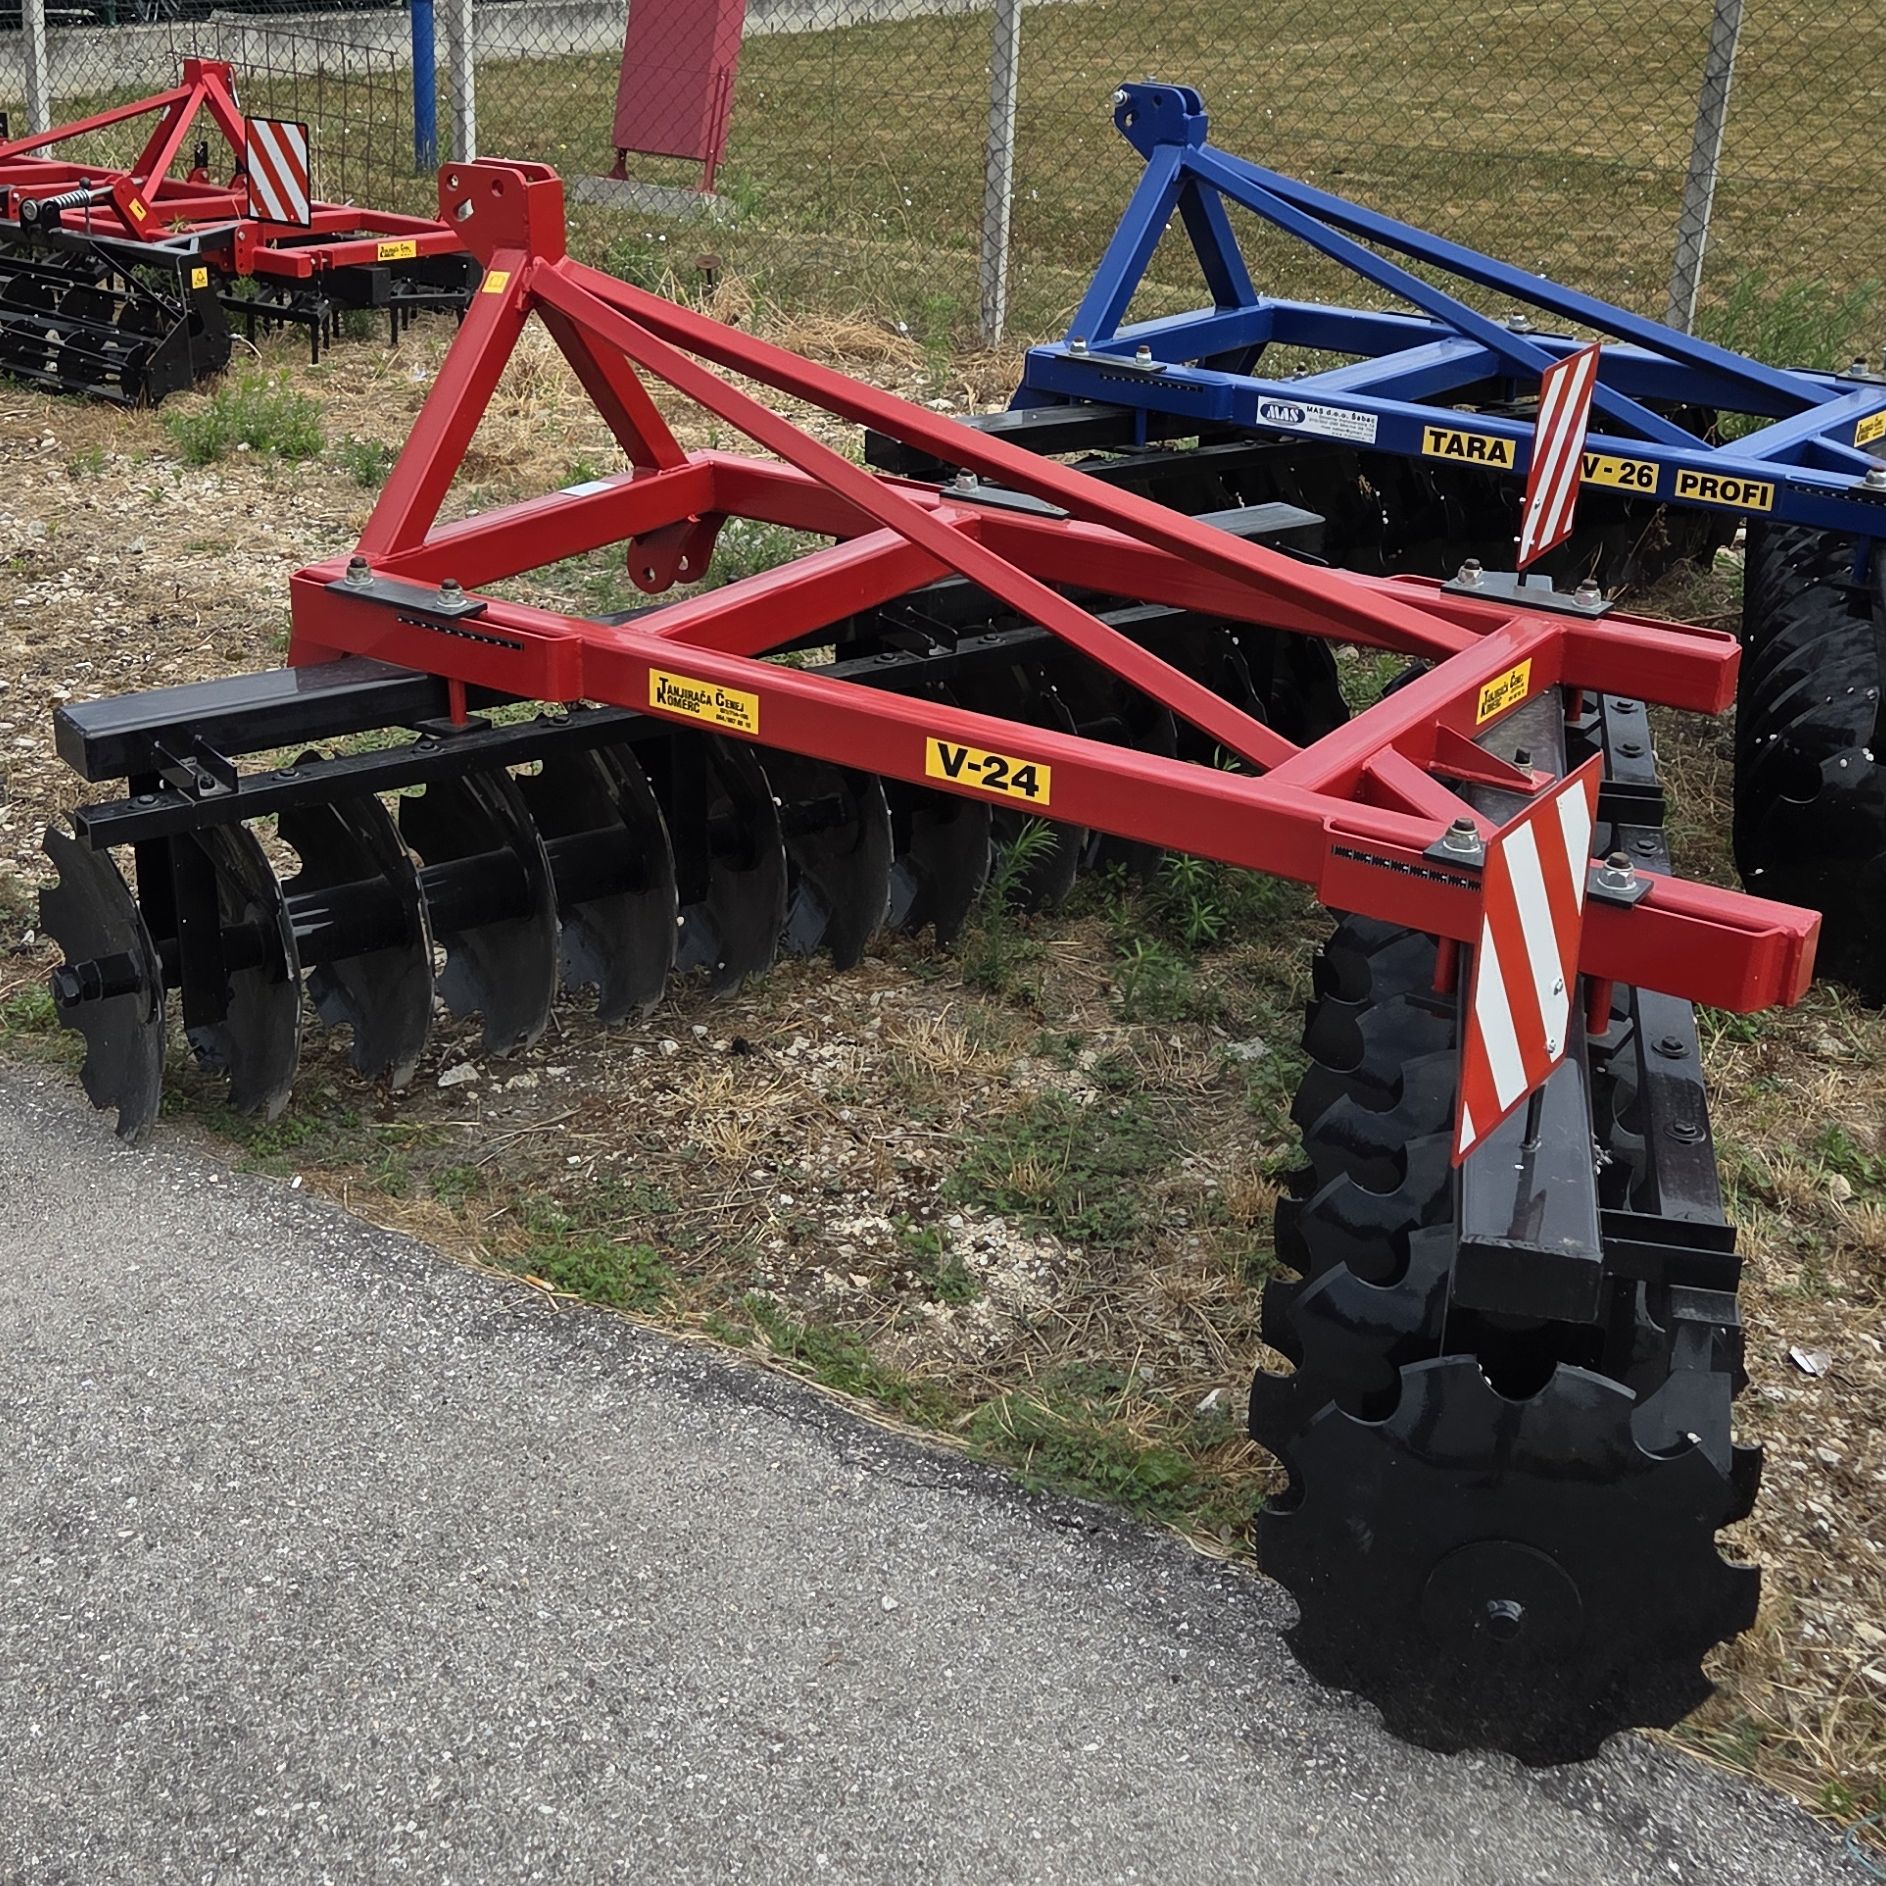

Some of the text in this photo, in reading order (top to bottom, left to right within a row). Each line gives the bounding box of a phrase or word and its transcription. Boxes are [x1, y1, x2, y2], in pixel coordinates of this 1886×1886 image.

[1266, 404, 1300, 422] MAS
[1306, 406, 1324, 415] MAS
[1429, 430, 1508, 464] TARA
[1680, 473, 1769, 507] PROFI
[657, 687, 701, 714] KOMERC
[937, 742, 1040, 798] V-24
